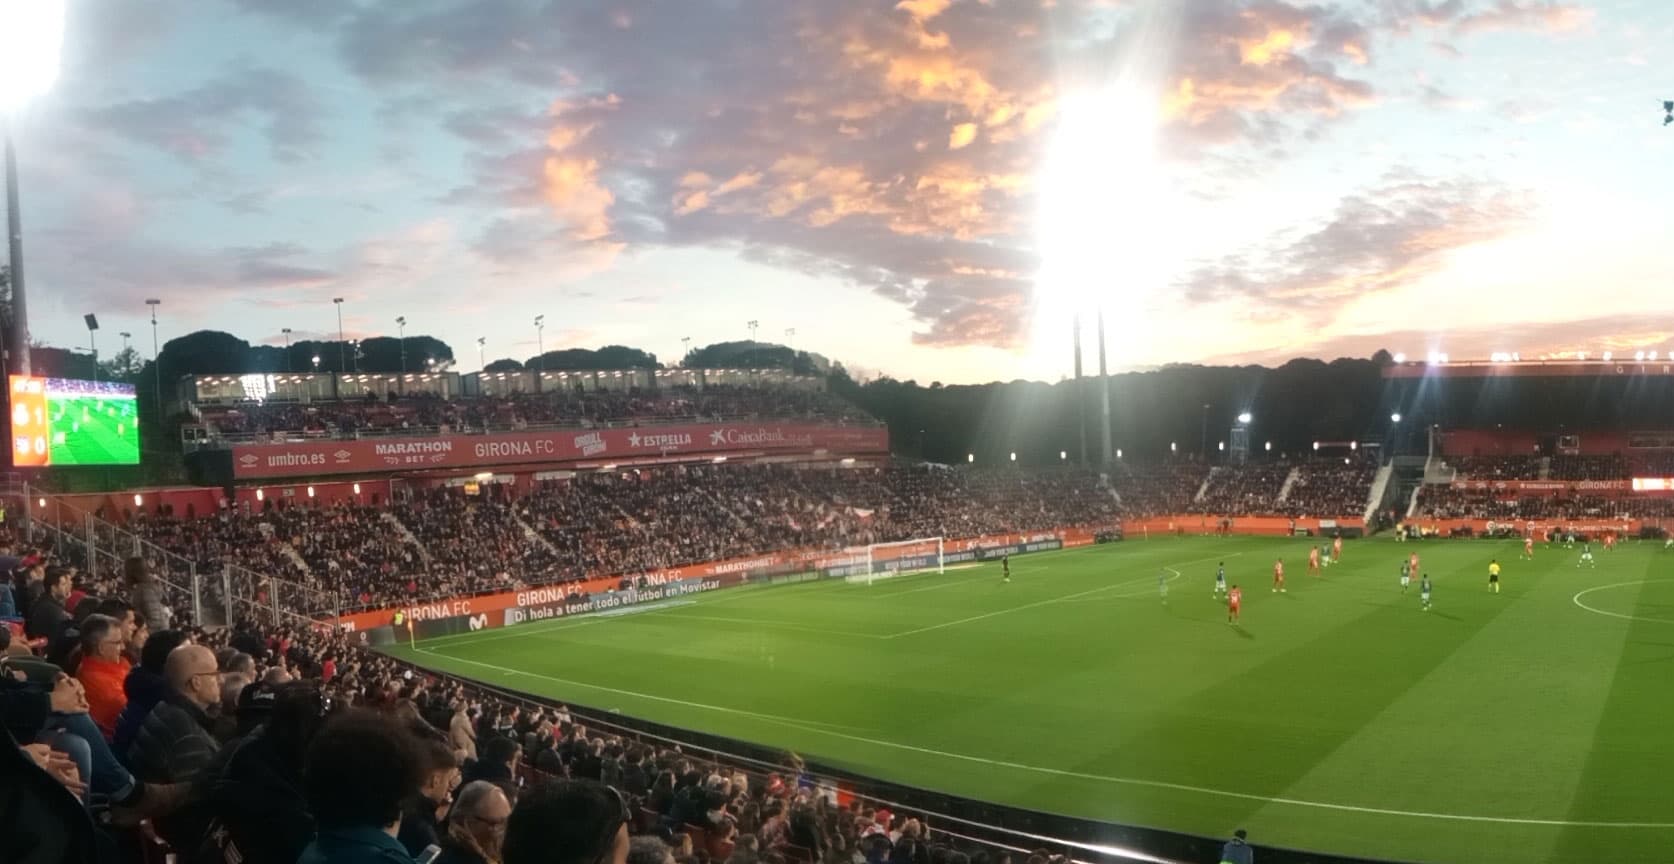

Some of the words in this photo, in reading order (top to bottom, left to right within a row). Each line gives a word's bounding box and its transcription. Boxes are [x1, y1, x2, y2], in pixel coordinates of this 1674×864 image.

[643, 433, 692, 447] ESTRELLA
[375, 441, 452, 455] MARATHON
[475, 441, 532, 457] GIRONA
[536, 440, 554, 454] FC
[268, 452, 326, 467] umbro.es
[405, 455, 425, 463] BET
[668, 570, 683, 582] FC
[515, 610, 526, 622] Di
[530, 606, 553, 619] hola
[556, 607, 563, 616] a
[566, 601, 593, 614] tener
[597, 595, 620, 608] todo
[623, 592, 631, 604] el
[666, 586, 678, 597] en
[680, 580, 720, 597] Movistar
[517, 588, 565, 606] GIRONA
[454, 601, 471, 616] FC
